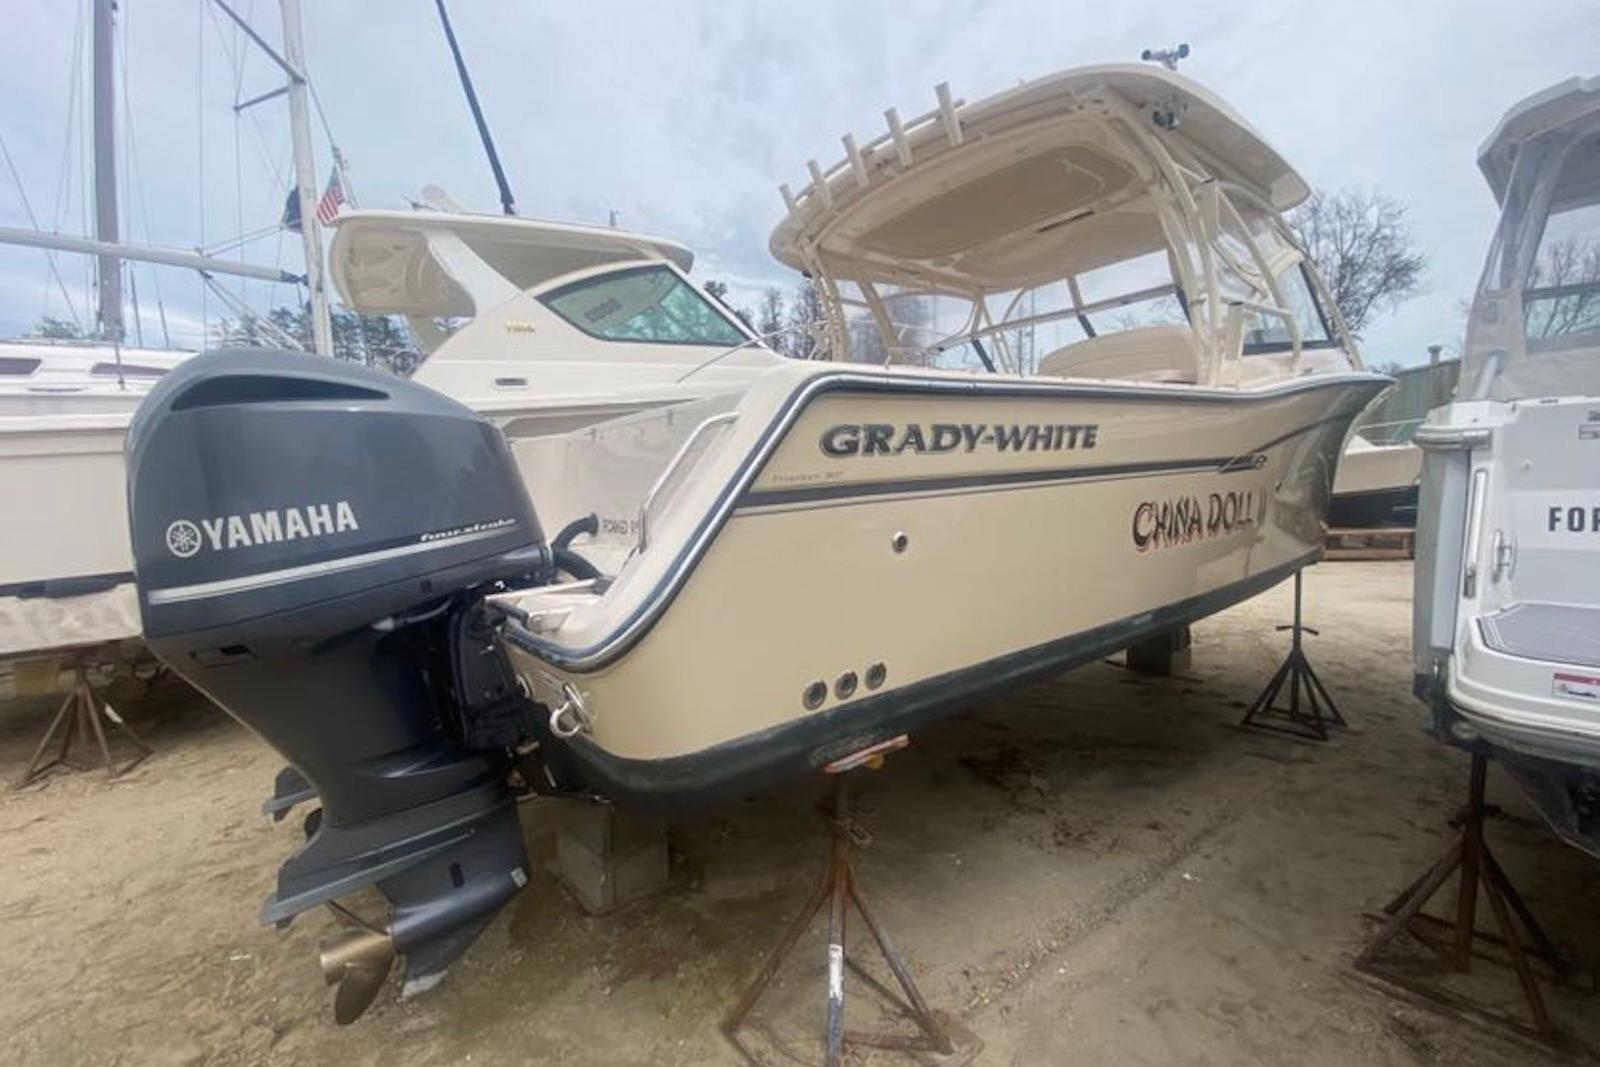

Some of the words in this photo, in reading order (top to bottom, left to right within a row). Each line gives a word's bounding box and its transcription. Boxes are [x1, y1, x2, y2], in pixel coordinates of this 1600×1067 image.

[819, 423, 1099, 458] GRADY-WHITE
[202, 500, 359, 551] YAMAHA
[1132, 495, 1203, 551] CHINA
[1207, 491, 1254, 533] DOLL
